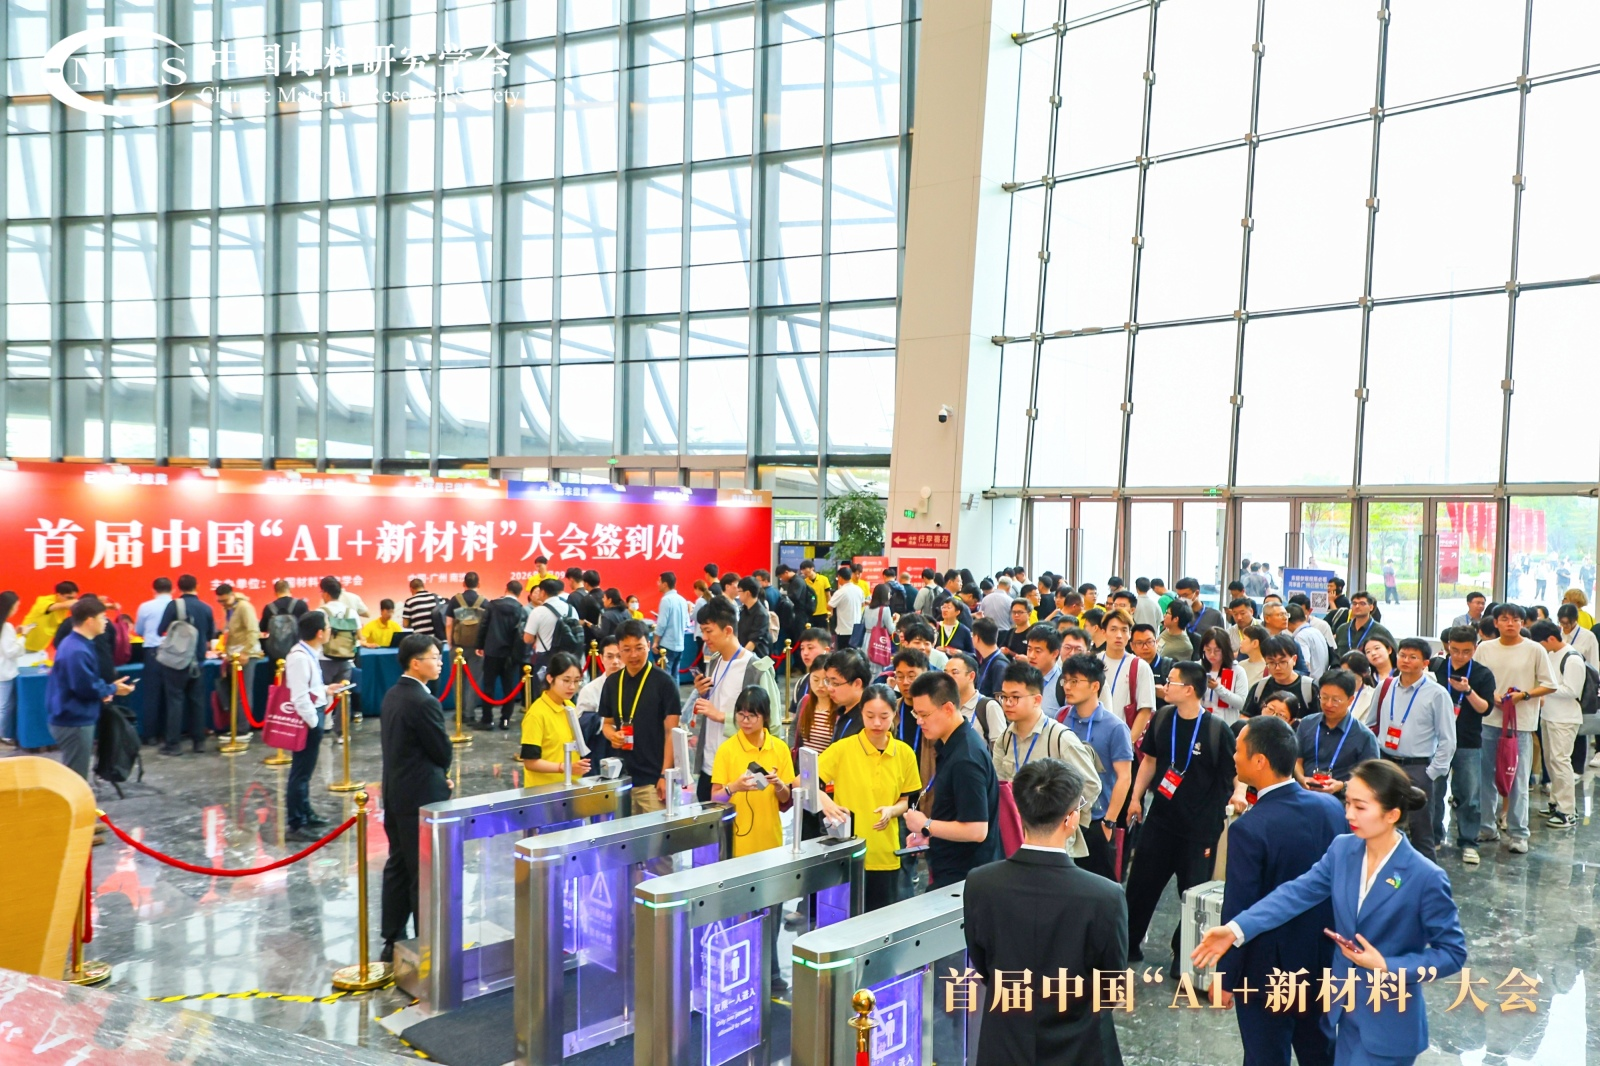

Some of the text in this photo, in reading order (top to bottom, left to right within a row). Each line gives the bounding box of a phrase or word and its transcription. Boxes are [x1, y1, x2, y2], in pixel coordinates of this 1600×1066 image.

[25, 517, 684, 570] 首届中国“AI+新材料”大会签到处
[271, 574, 364, 589] 国材料学会
